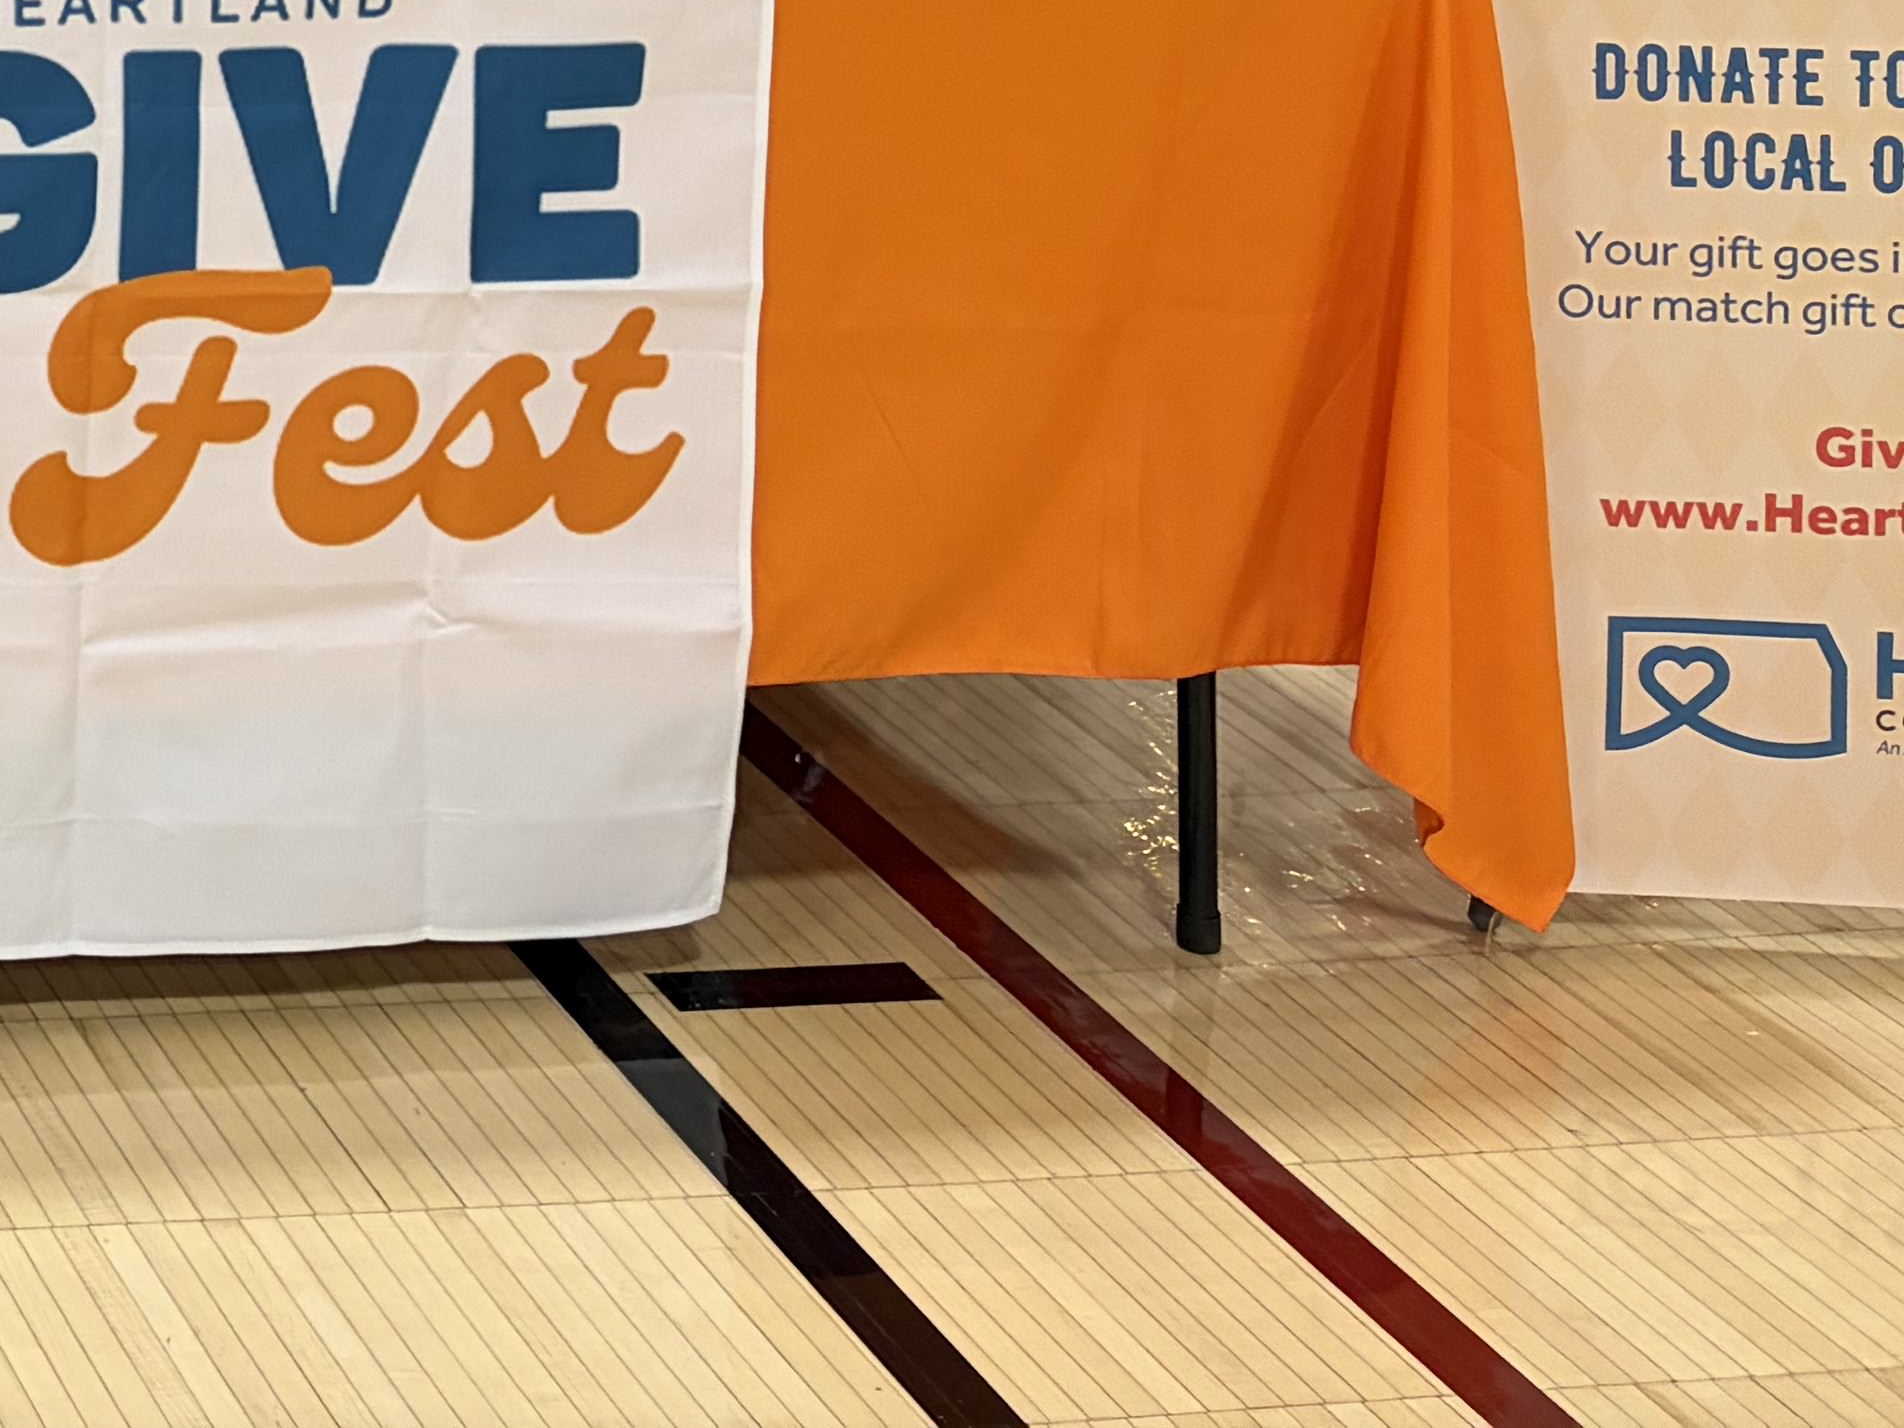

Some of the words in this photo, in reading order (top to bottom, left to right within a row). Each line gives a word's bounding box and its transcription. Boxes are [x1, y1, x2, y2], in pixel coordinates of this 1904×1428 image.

[1591, 41, 1825, 106] DONATE
[1849, 49, 1904, 108] TO
[1667, 129, 1847, 192] LOCAL
[1575, 230, 1679, 266] Your
[1689, 235, 1763, 278] gift
[1773, 245, 1880, 280] goes
[1558, 283, 1642, 319] Our
[1652, 291, 1790, 325] match
[1801, 292, 1877, 335] gift
[8, 265, 686, 568] Fest
